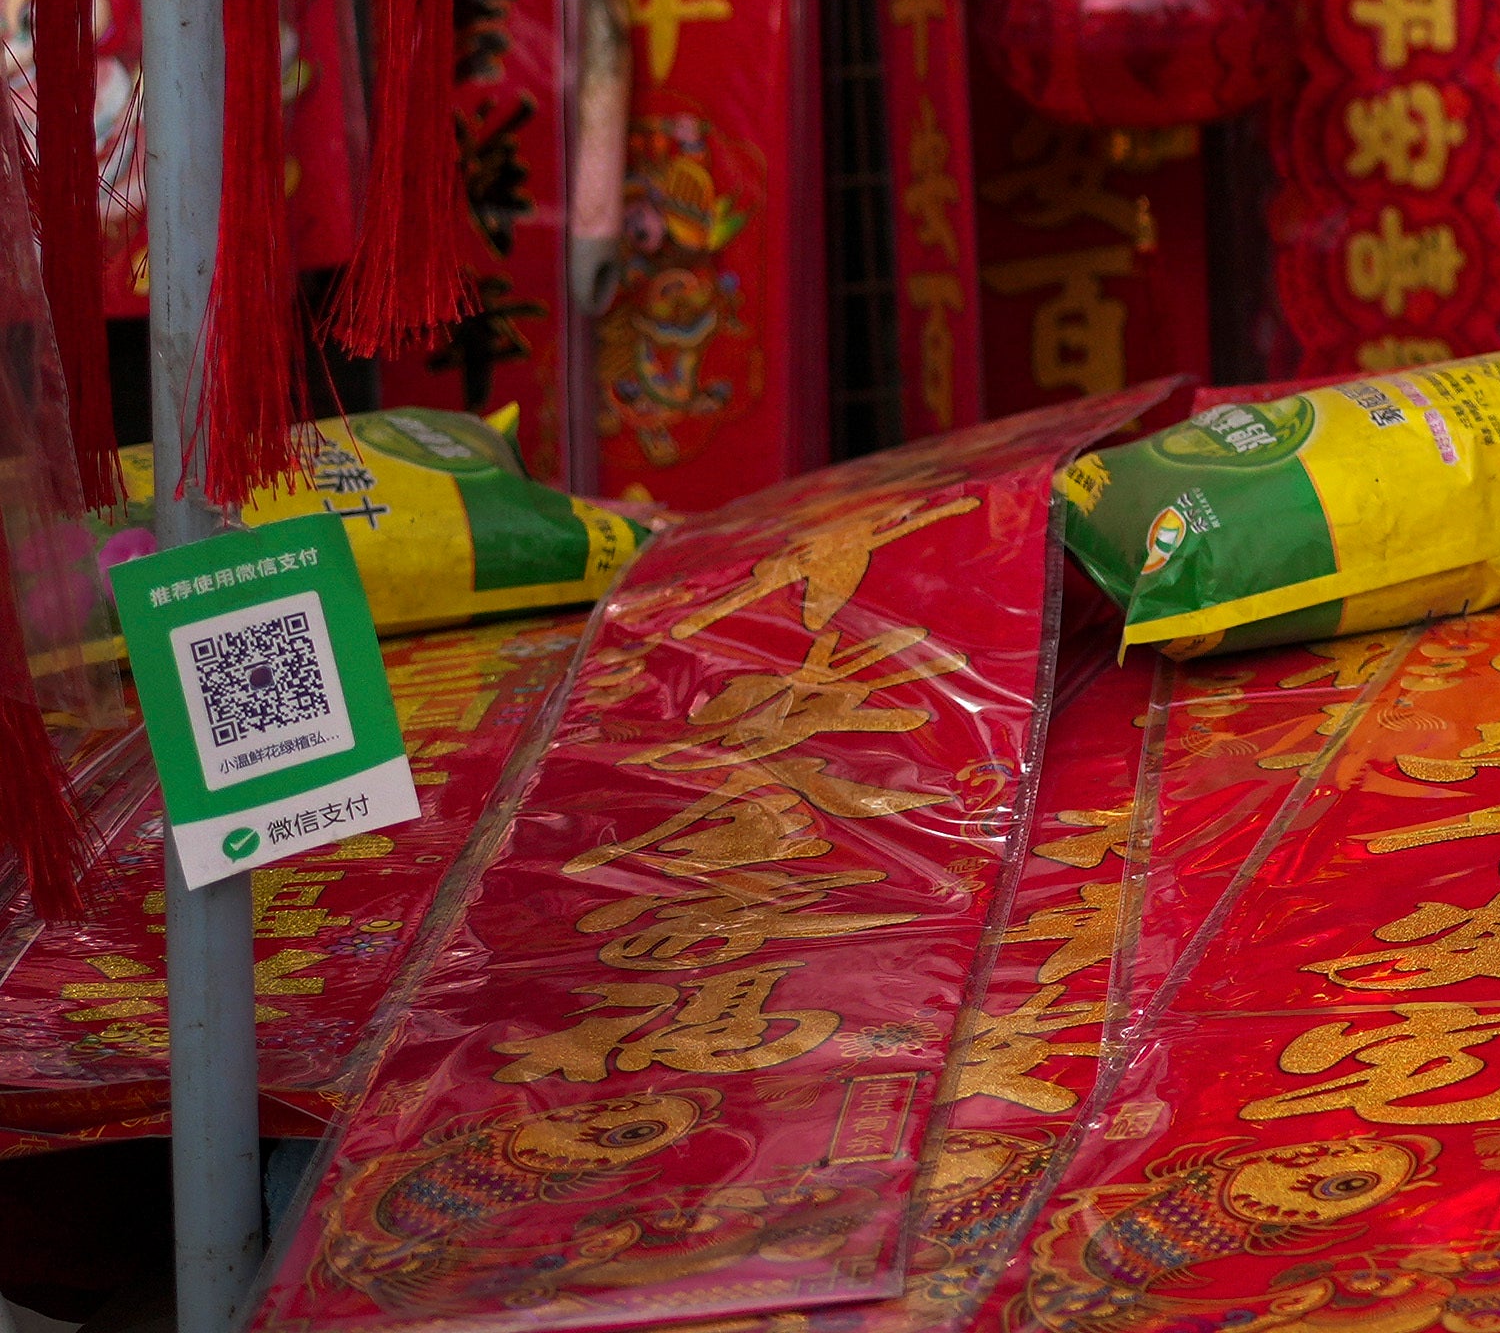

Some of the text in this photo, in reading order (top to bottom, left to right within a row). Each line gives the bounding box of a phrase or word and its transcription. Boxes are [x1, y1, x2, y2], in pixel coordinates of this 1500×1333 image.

[149, 546, 320, 609] 推荐使用微信支付
[266, 792, 371, 846] 微信支付
